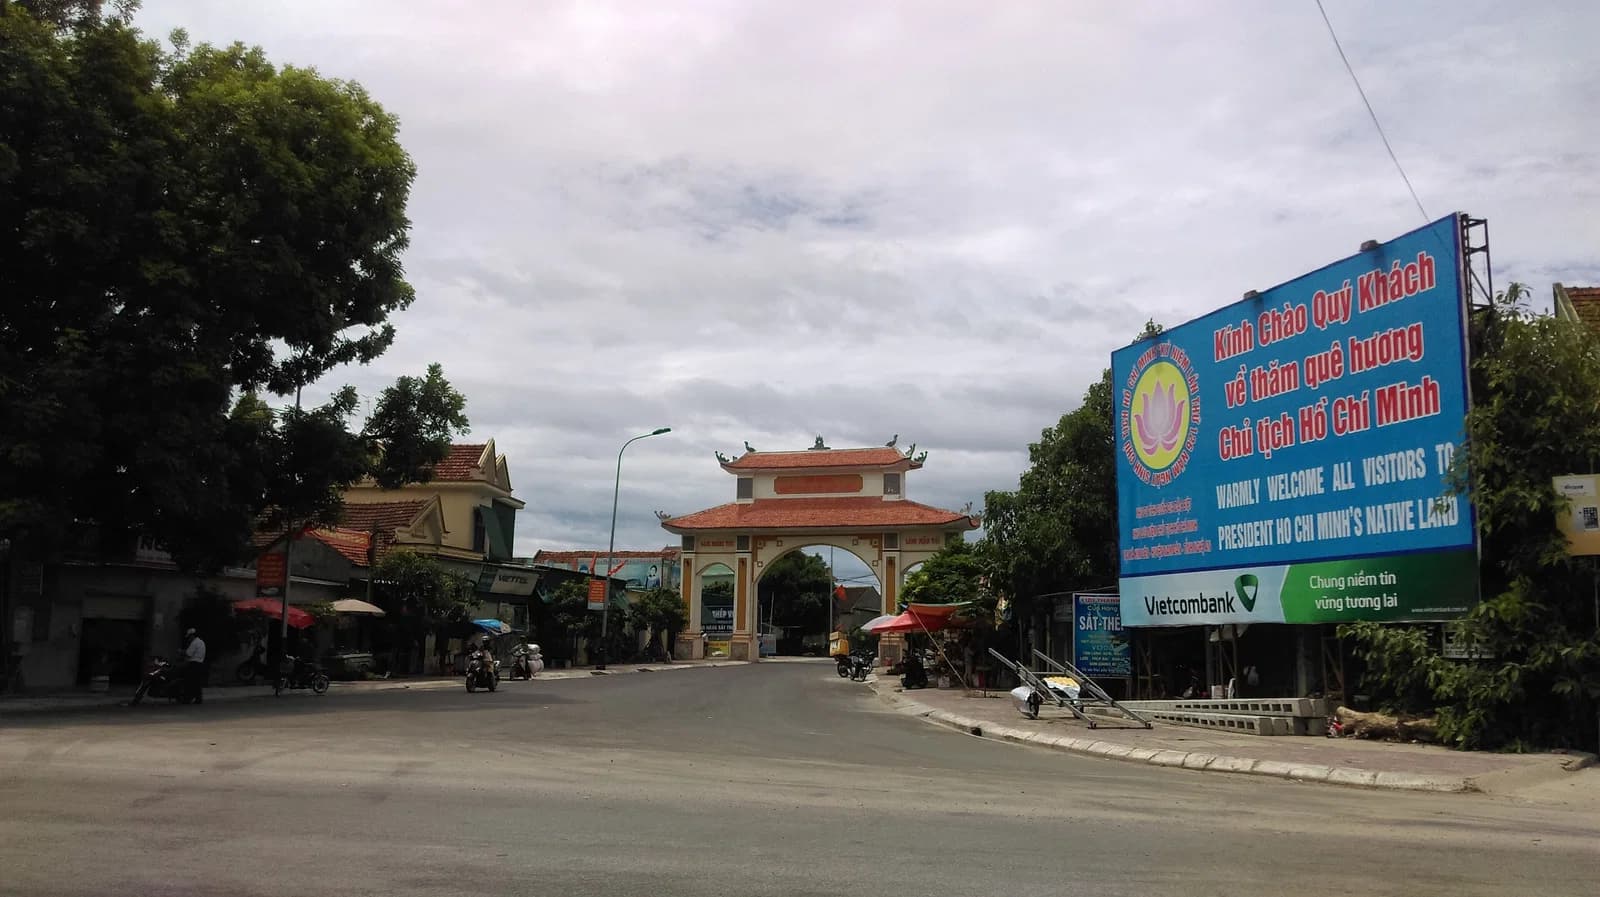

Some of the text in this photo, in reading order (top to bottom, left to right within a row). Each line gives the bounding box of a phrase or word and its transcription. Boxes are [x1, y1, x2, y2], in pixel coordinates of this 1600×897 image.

[1213, 251, 1435, 363] Kính Chào Quý Khách
[1225, 321, 1424, 408] về thăm quê hương
[1218, 375, 1440, 461] Chủ tịch Hồ Chí Minh
[1216, 478, 1260, 509] WARMLY
[1267, 466, 1325, 502] WELCOME
[1332, 461, 1355, 492] ALL
[1363, 447, 1427, 487] VISITORS
[1218, 519, 1274, 551] PRESIDENT
[1276, 517, 1292, 545] HO
[1294, 514, 1315, 544] CHI
[1317, 505, 1363, 540] MINH'S
[1366, 500, 1415, 535] NATIVE
[1418, 495, 1459, 529] LAND
[1144, 591, 1236, 615] Vietcombank
[1310, 575, 1345, 590] Chung
[1379, 571, 1397, 585] tin
[1382, 593, 1398, 608] lai
[1079, 612, 1124, 631] SẮT-THÉ
